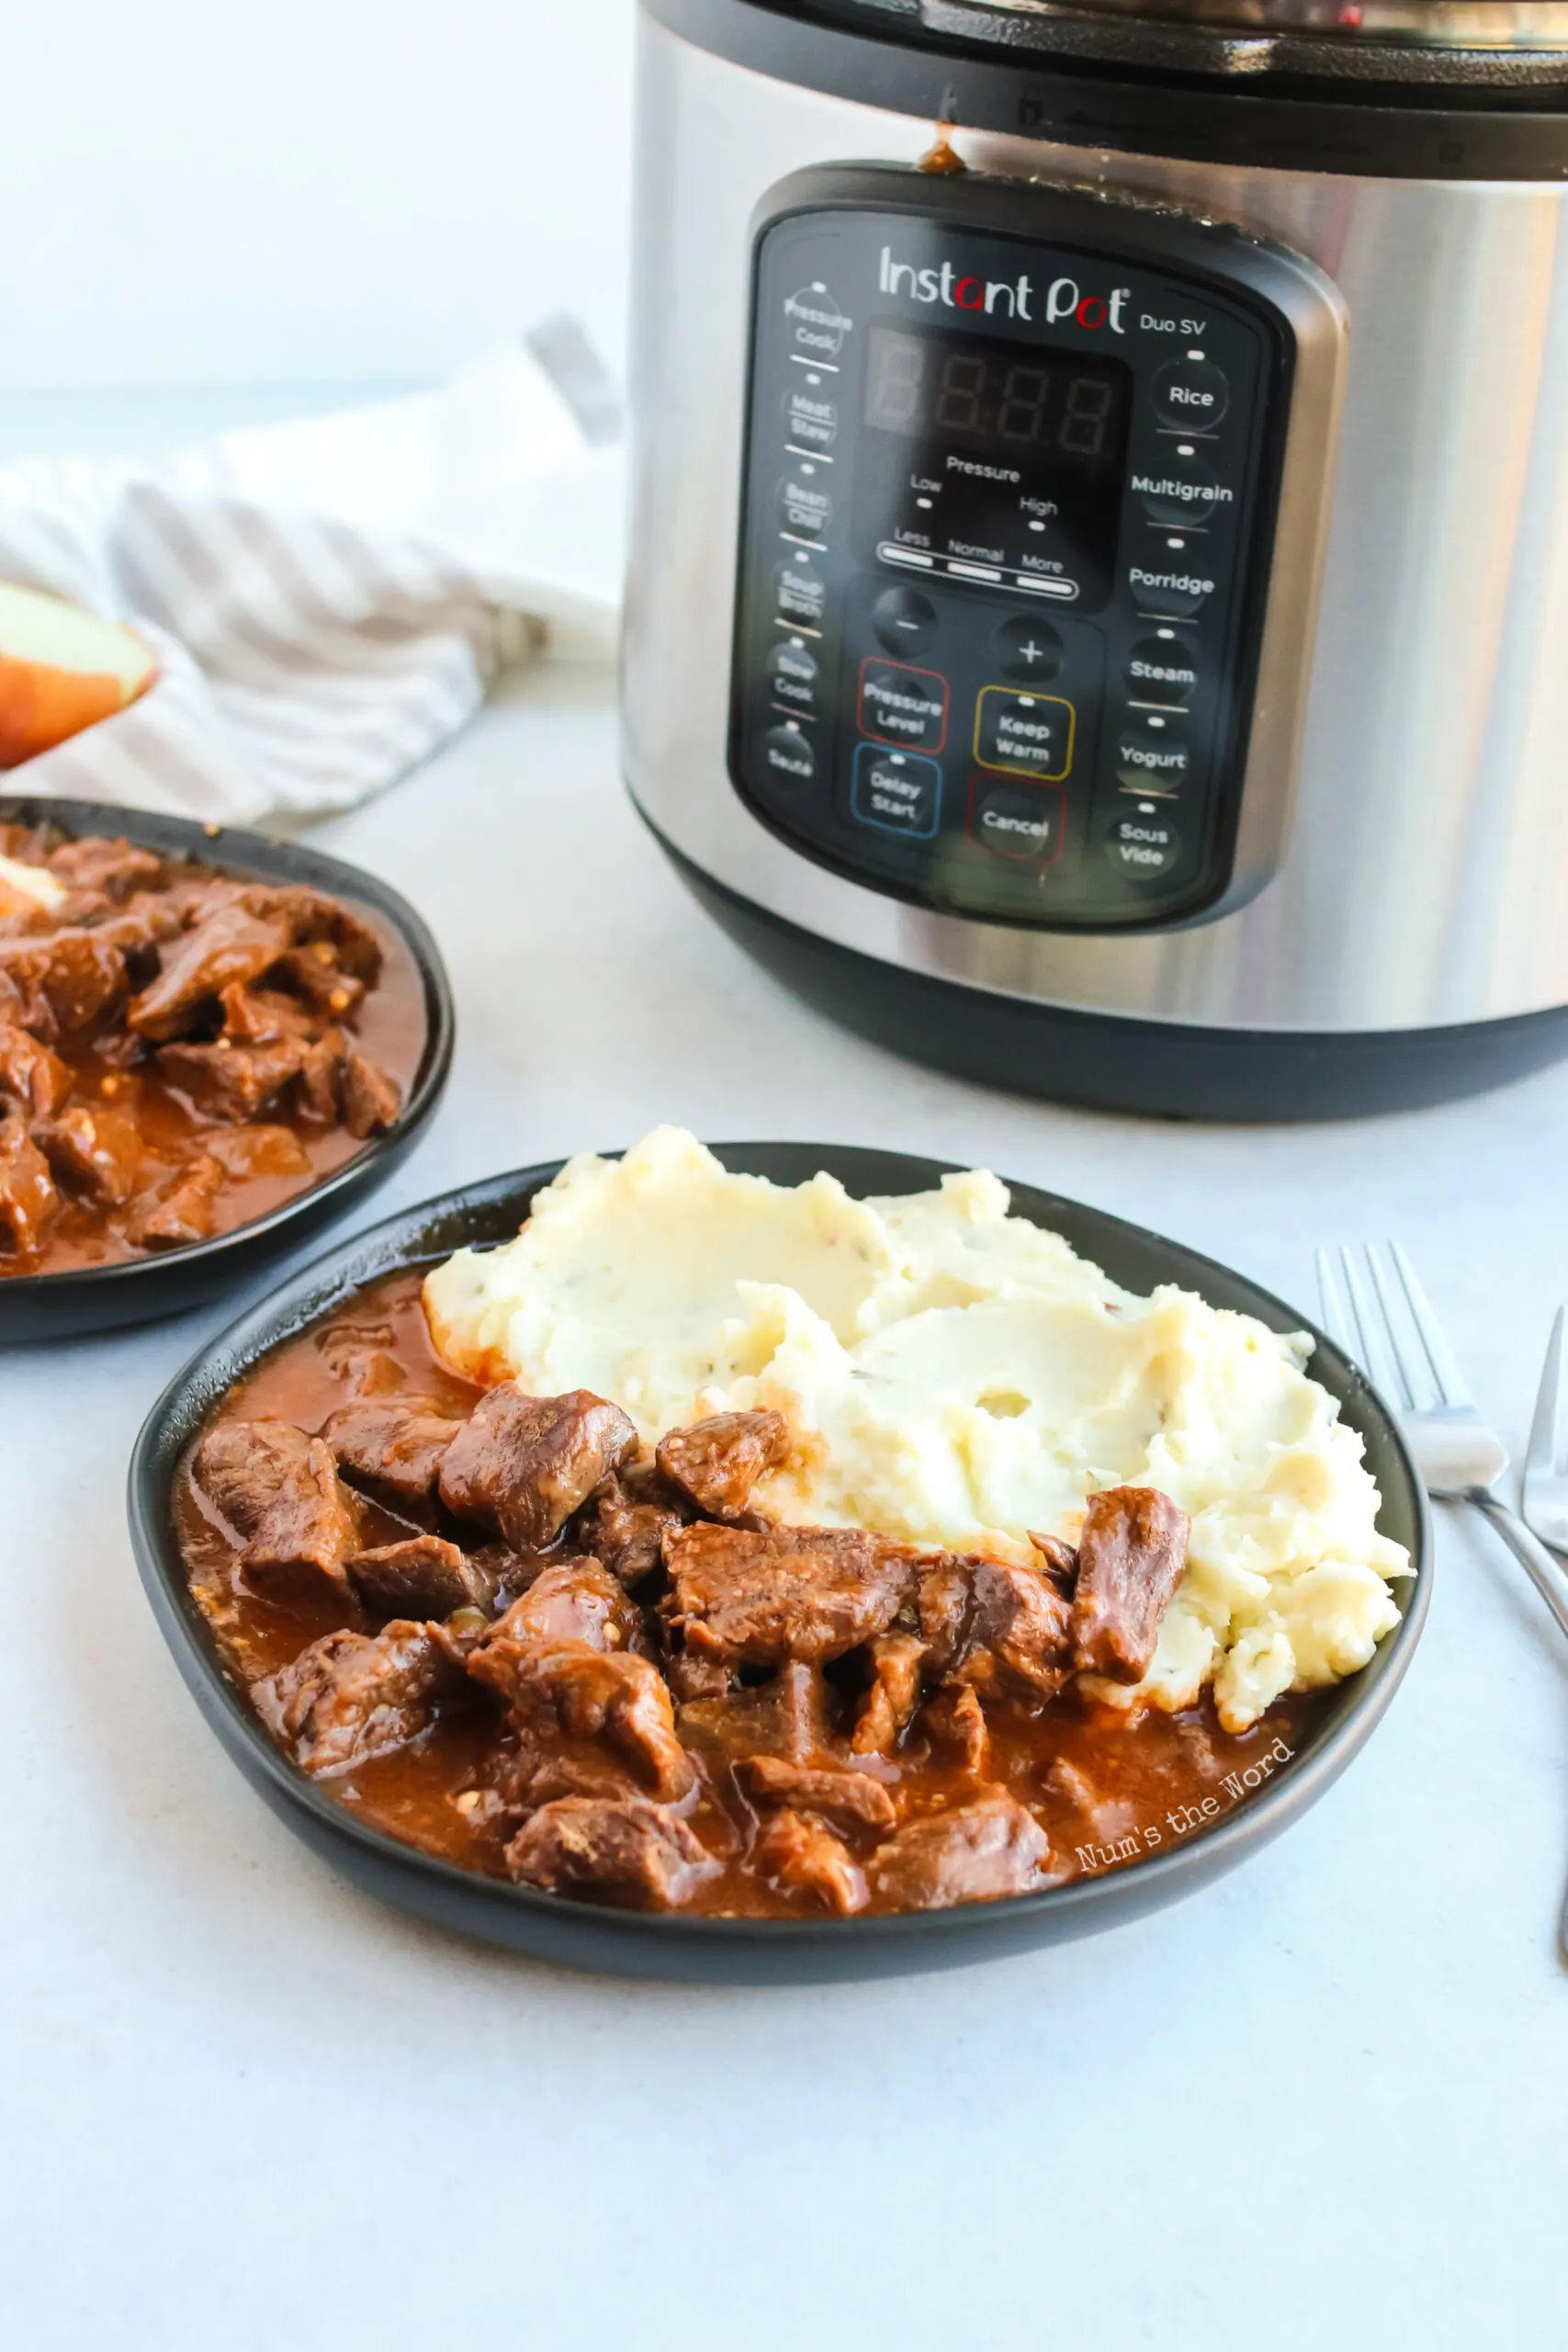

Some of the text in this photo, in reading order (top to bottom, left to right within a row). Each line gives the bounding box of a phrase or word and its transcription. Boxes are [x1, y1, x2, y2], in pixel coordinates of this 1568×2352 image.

[879, 246, 1032, 321] Instant
[784, 298, 853, 332] Pressure
[1140, 314, 1207, 335] Duo SV
[795, 326, 838, 351] Cook
[792, 394, 832, 419] Meat
[1169, 387, 1214, 406] Rice
[791, 417, 831, 441] Stew
[947, 456, 1021, 483] Pressure
[911, 474, 942, 493] Low
[1132, 476, 1234, 503] Multigrain
[1020, 496, 1058, 518] High
[894, 527, 1064, 574] Less Normal More
[1130, 569, 1215, 594] Porridge
[1131, 662, 1196, 684] Steam
[863, 683, 943, 717] Pressure
[877, 710, 925, 734] Level
[999, 715, 1050, 741] Keep
[996, 737, 1049, 762] Warm
[1121, 746, 1186, 770] Yogurt
[870, 771, 921, 800] Delay
[872, 794, 916, 820] Start
[983, 810, 1049, 838] Cancel
[1120, 823, 1168, 844] Sous
[1120, 845, 1164, 865] Vide
